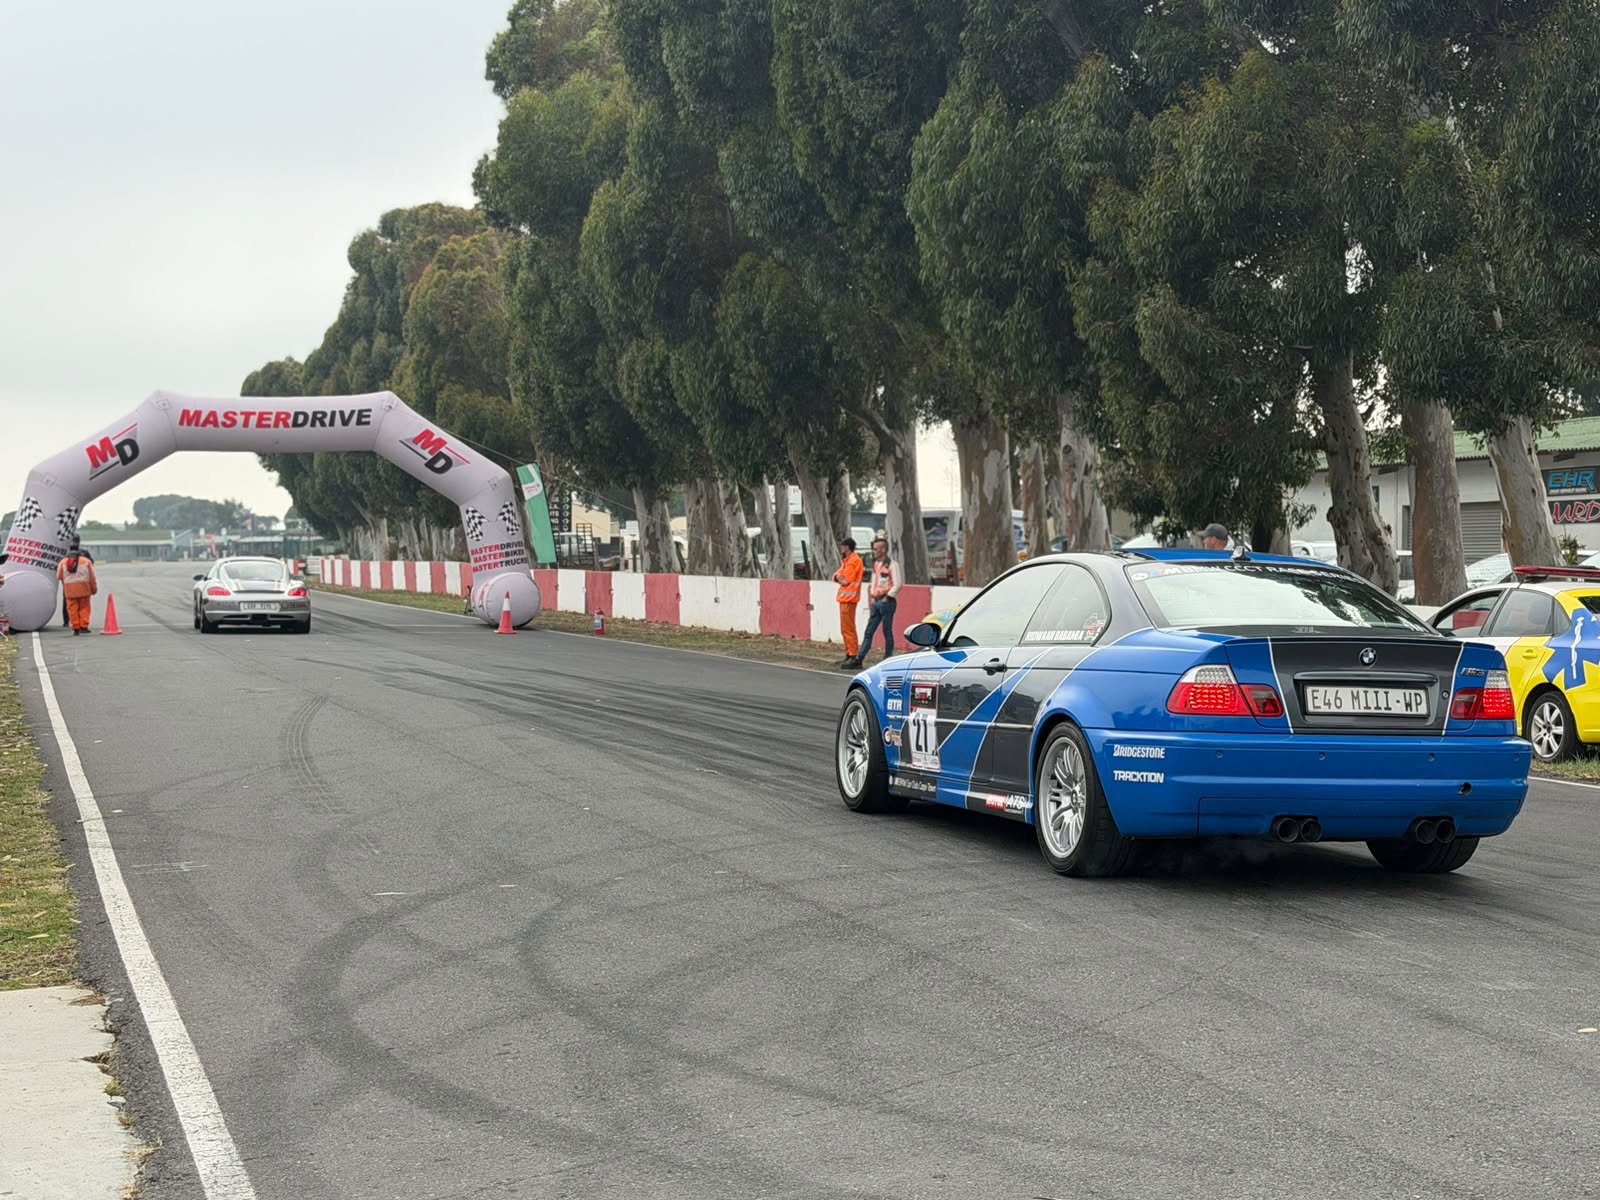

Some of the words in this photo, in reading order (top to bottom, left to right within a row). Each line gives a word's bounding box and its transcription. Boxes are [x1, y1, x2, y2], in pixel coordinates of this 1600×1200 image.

[178, 408, 372, 429] MASTERDRIVE
[1549, 470, 1595, 492] EHR
[1311, 689, 1343, 710] E46
[913, 718, 929, 753] 21
[1113, 744, 1166, 759] BRIDGESTONE
[1113, 770, 1165, 784] TRACKTION
